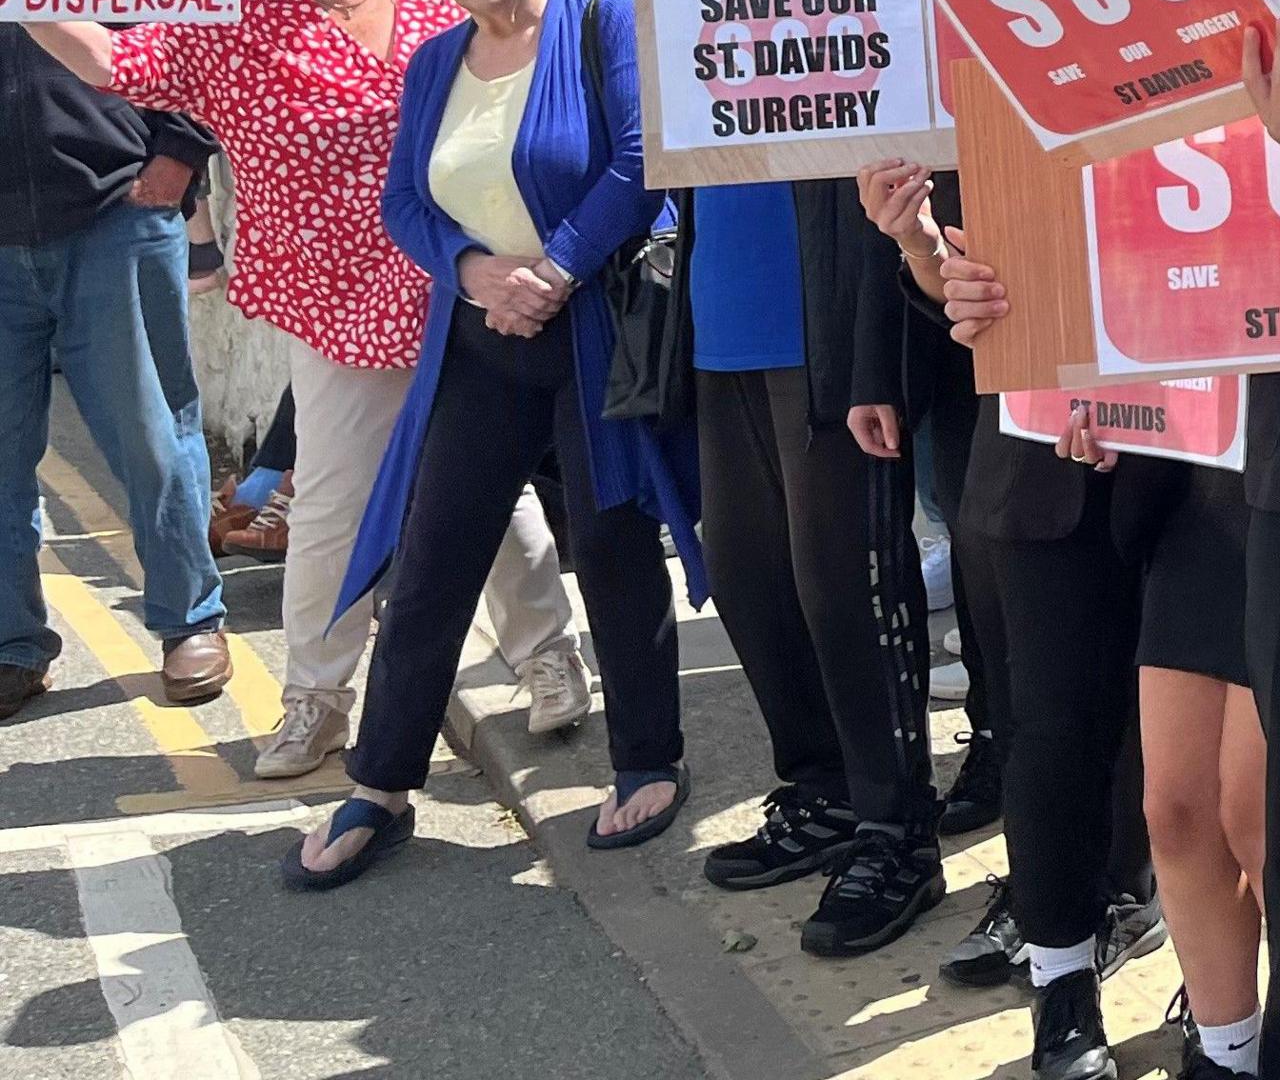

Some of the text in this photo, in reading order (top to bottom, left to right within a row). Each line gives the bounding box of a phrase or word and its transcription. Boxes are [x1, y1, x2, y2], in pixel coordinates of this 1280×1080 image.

[693, 32, 891, 81] ST. DAVIDS
[1048, 10, 1241, 86] SAVE OUR SURGERY
[1114, 59, 1213, 105] ST DAVIDS
[711, 90, 880, 137] SURGERY
[1167, 264, 1220, 291] SAVE
[1244, 306, 1280, 339] ST
[1096, 402, 1166, 433] DAVIDS
